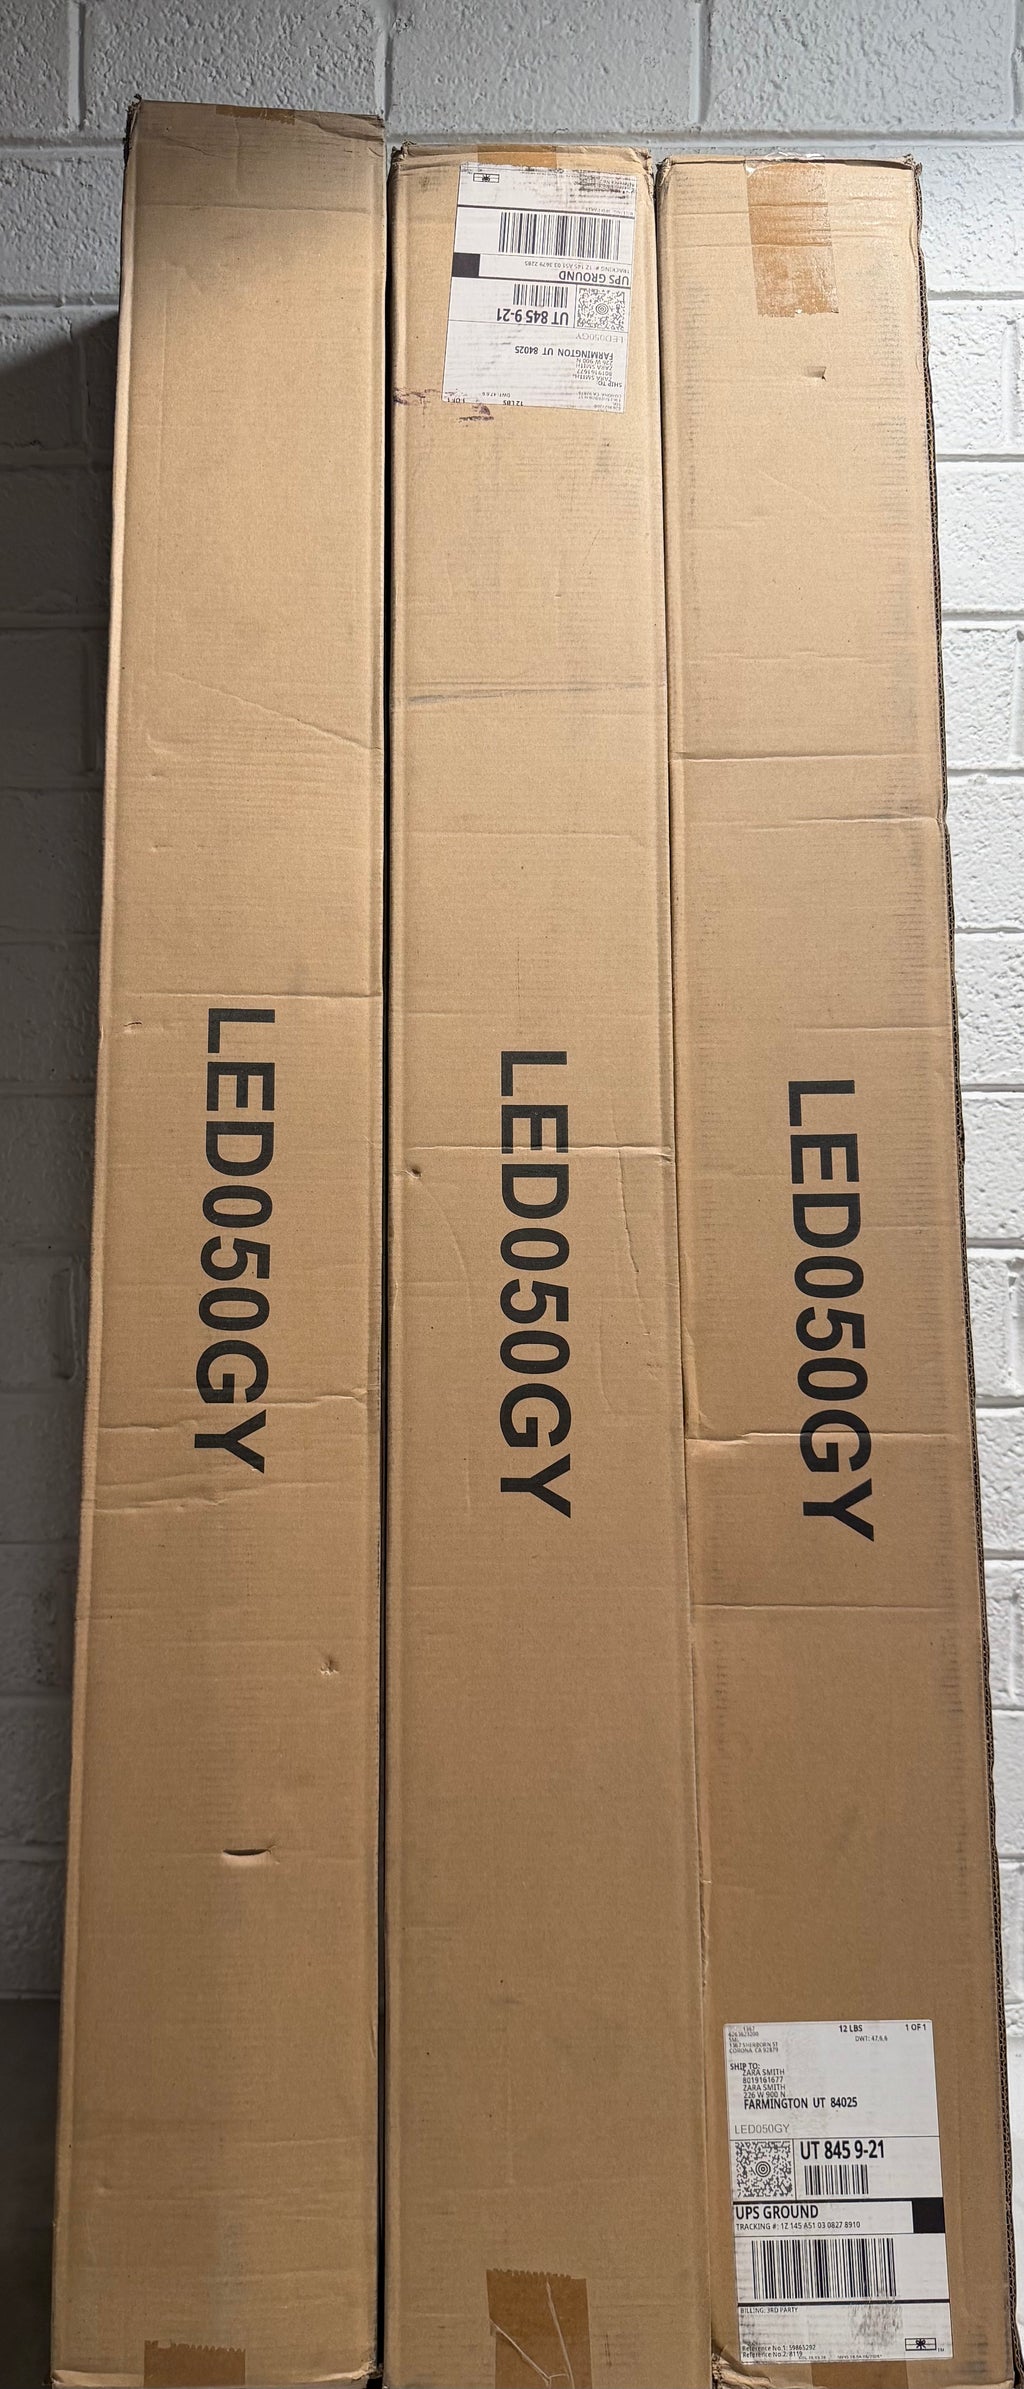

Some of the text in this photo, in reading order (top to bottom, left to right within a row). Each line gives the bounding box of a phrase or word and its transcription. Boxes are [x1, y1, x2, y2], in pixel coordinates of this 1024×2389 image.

[559, 270, 629, 286] UPS GROUND
[496, 308, 569, 326] UT 845 9-21
[515, 346, 613, 360] FARMINGTON UT 84025
[194, 1008, 275, 1474] LED050GY
[500, 1050, 571, 1519] LED050GY
[788, 1079, 874, 1542] LED050GY
[742, 2076, 784, 2084] 8019161677
[744, 2097, 857, 2110] FARMINGTON UT 84025
[734, 2123, 790, 2134] LED050GY
[800, 2140, 884, 2159] UT 845 9-21
[736, 2205, 819, 2220] UPS GROUND
